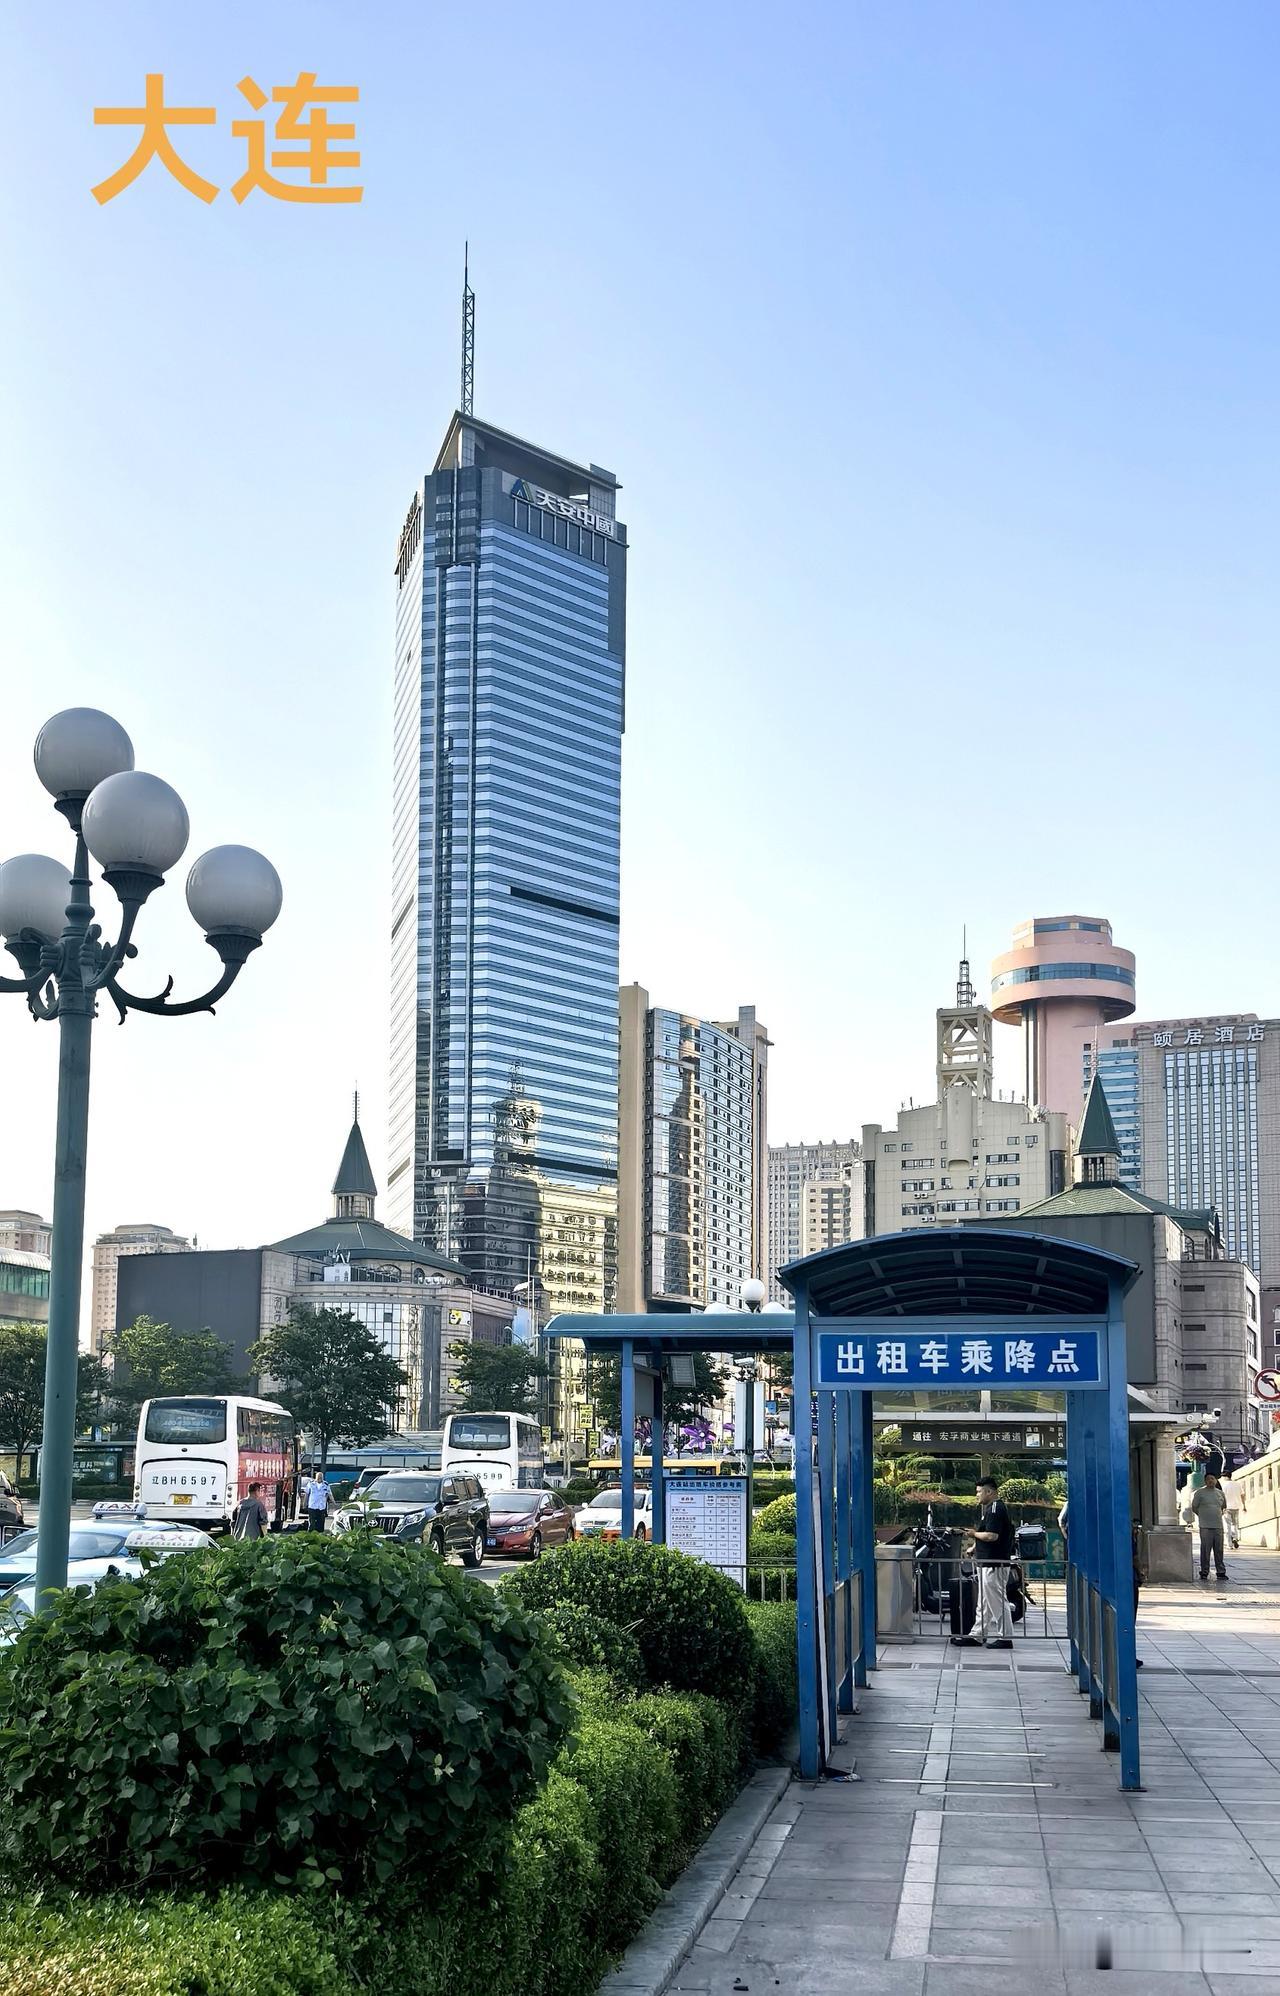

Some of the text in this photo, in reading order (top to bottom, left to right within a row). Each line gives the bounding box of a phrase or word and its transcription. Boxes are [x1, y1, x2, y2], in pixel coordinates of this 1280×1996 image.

[1153, 1024, 1265, 1047] 颐居酒店
[836, 1339, 1080, 1375] 出租车乘降点
[912, 1432, 932, 1442] 通往
[152, 1475, 217, 1486] 辽BH6597
